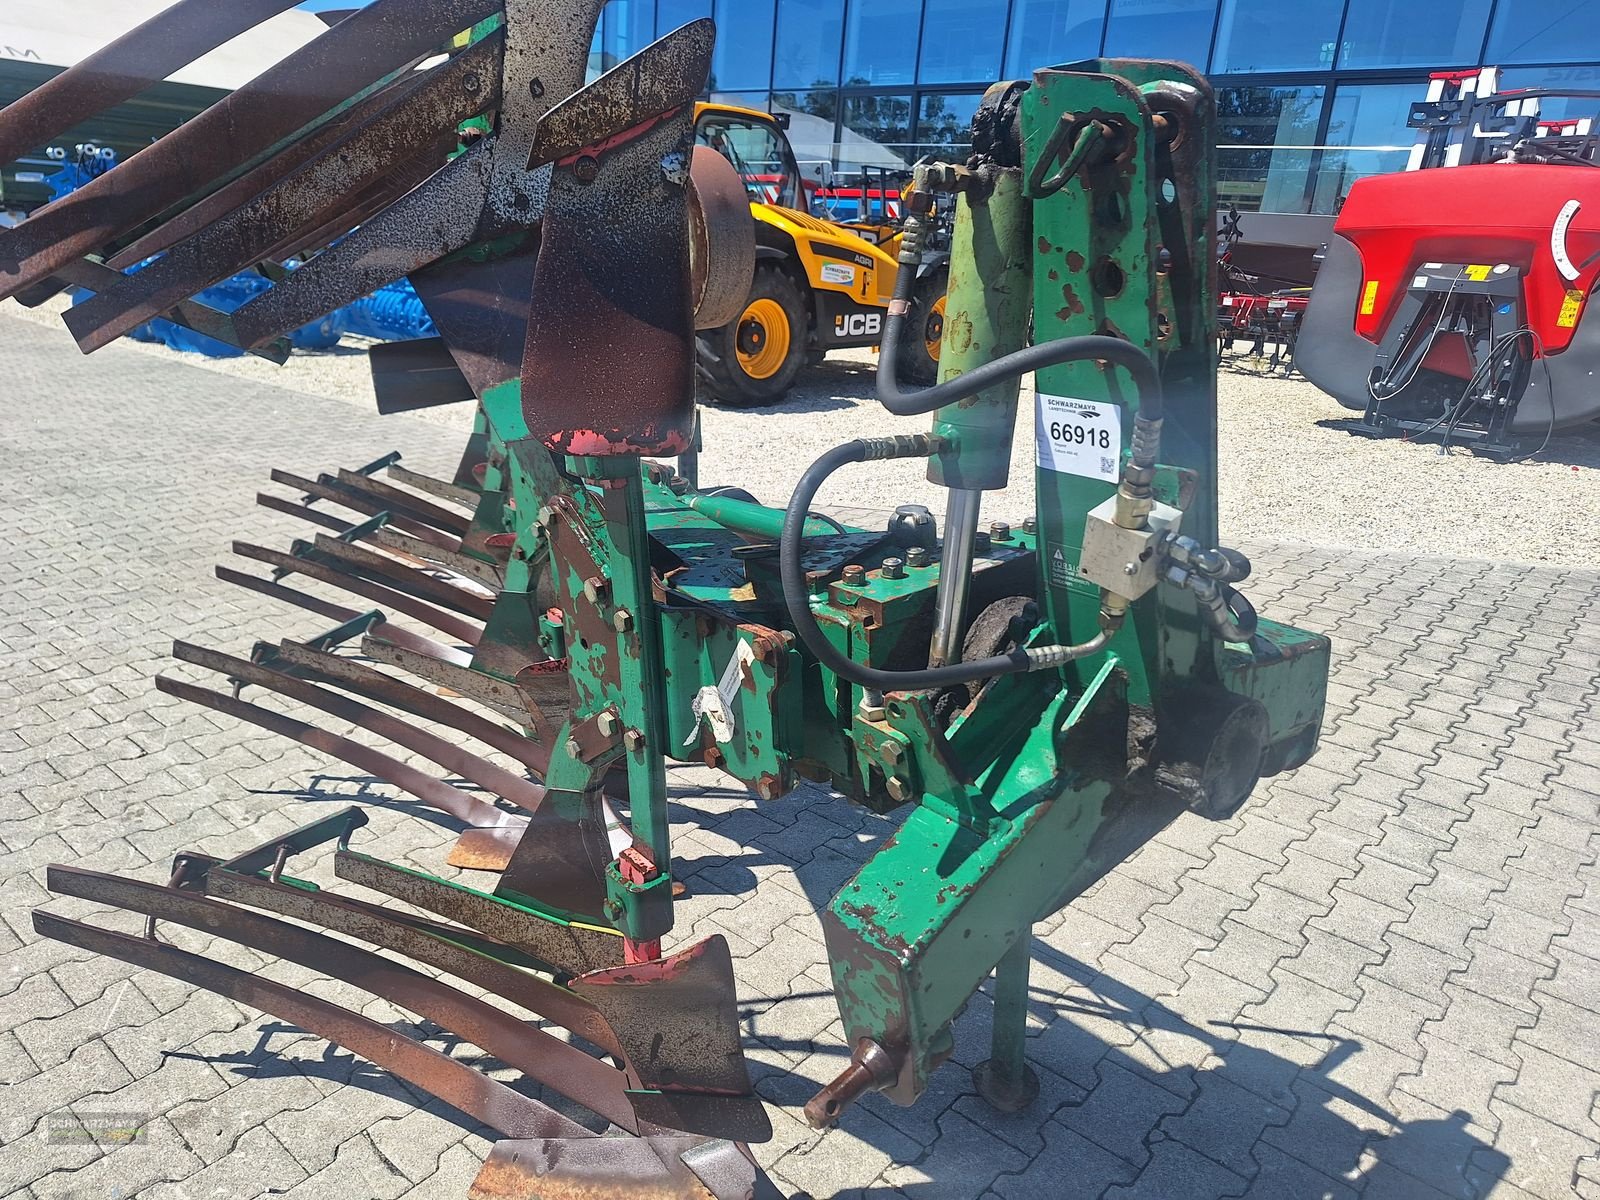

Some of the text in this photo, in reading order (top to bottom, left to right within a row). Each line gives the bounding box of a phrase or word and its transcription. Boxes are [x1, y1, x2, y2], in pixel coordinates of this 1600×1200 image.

[854, 254, 873, 268] AGRI
[835, 314, 881, 337] JCB
[1047, 399, 1096, 411] SCHWARZMAYR
[1050, 421, 1110, 449] 66918
